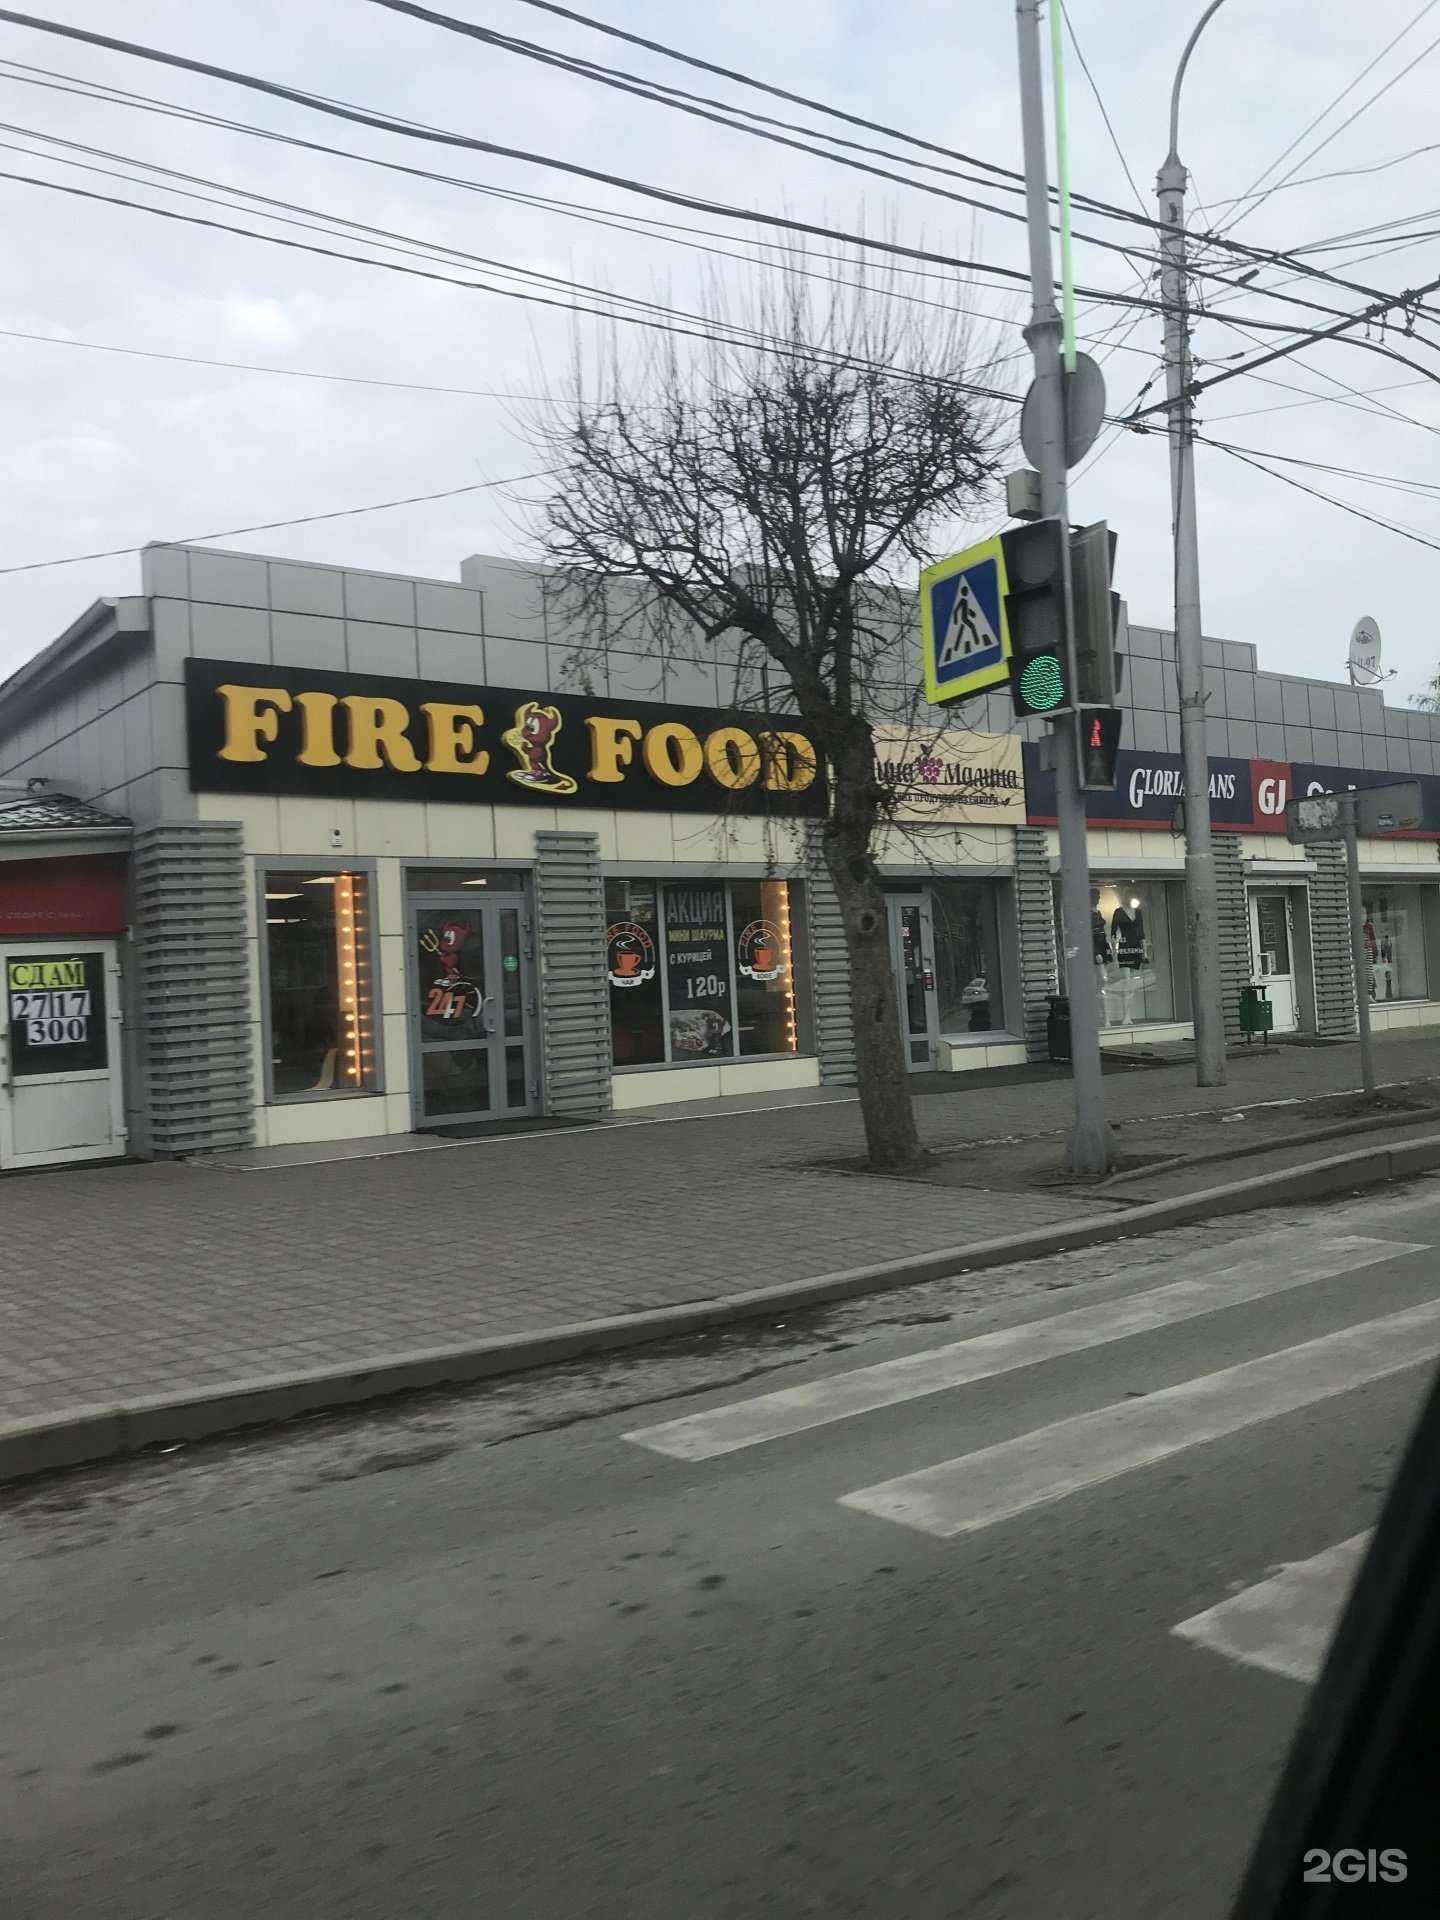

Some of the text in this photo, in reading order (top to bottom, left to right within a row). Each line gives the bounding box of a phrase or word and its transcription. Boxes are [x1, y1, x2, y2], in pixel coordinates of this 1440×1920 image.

[216, 684, 817, 793] FIRE FOOD
[1206, 773, 1236, 799] ANS
[1258, 778, 1286, 814] GJ
[667, 891, 724, 925] АКЦИЯ
[677, 948, 713, 964] КУРИЦЕЙ
[12, 963, 83, 987] СДАМ
[686, 974, 726, 999] 120р
[30, 1018, 84, 1043] 300
